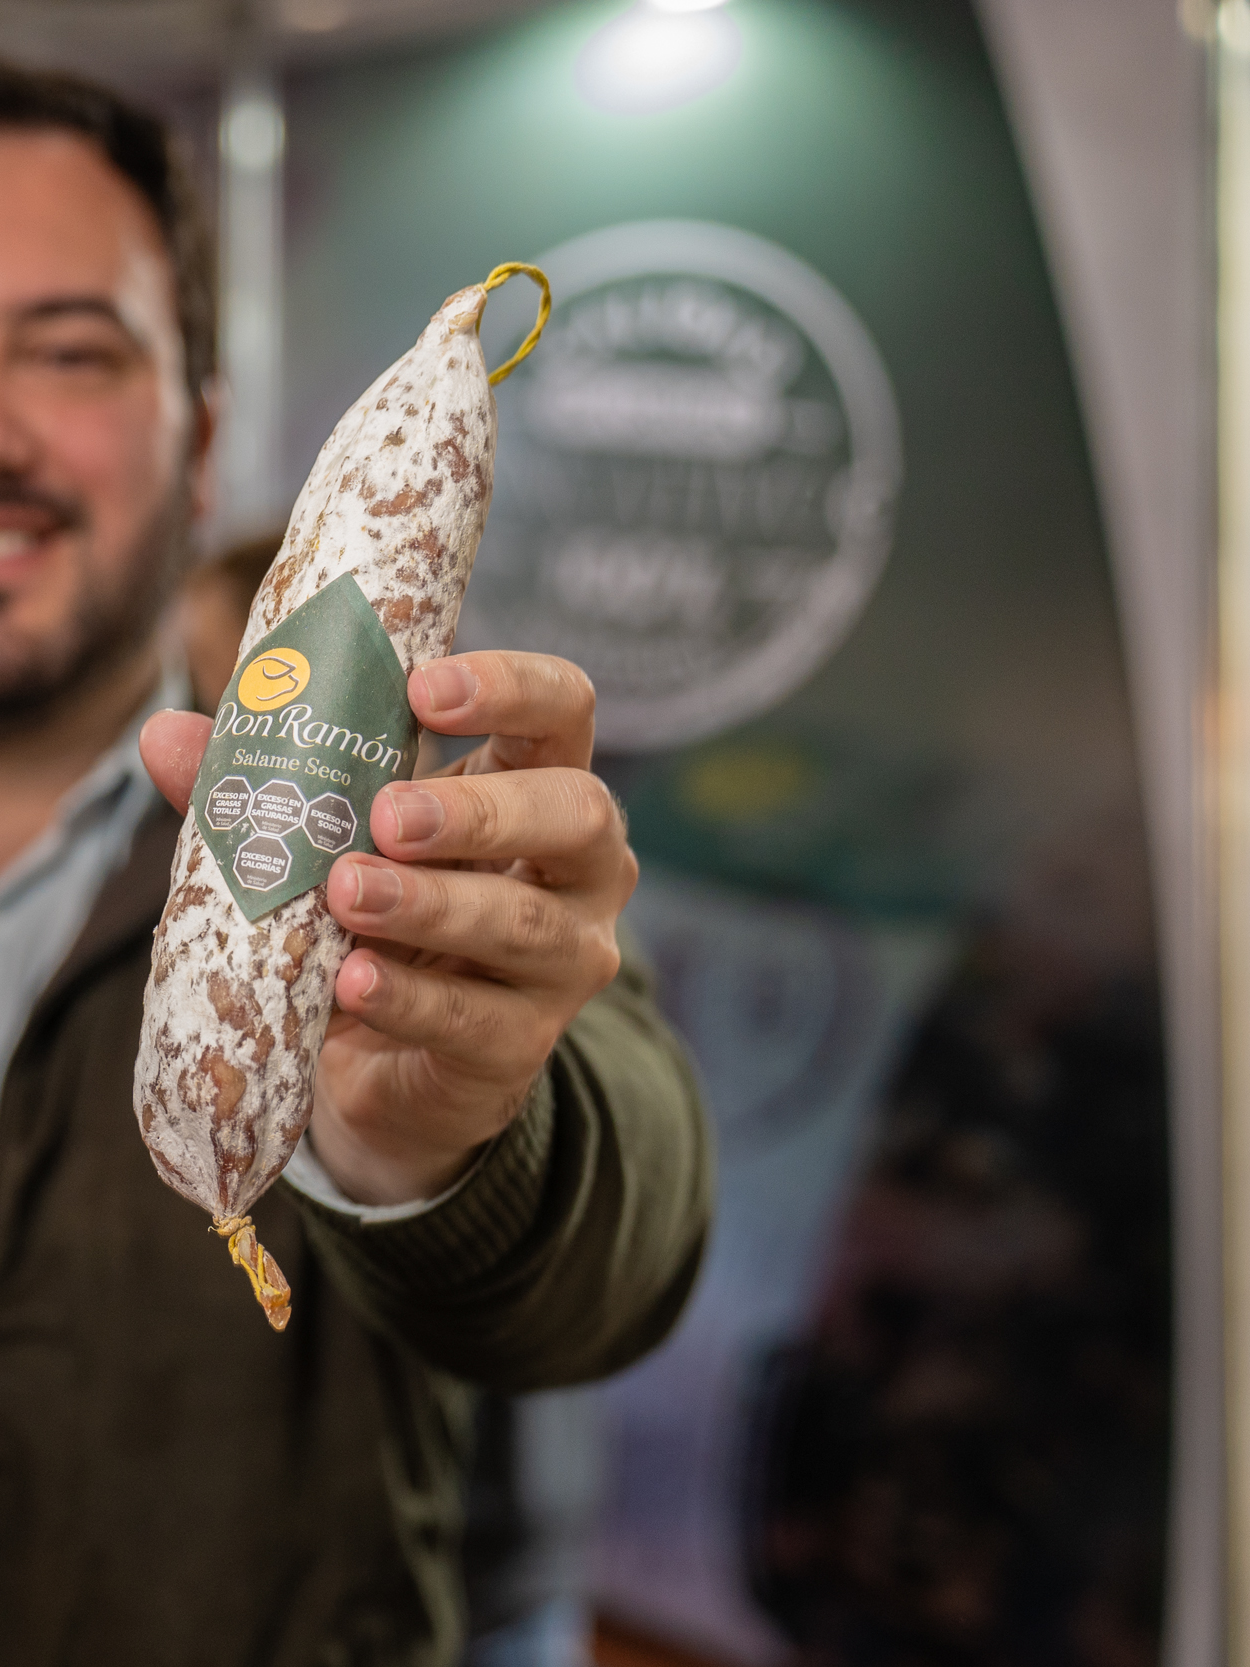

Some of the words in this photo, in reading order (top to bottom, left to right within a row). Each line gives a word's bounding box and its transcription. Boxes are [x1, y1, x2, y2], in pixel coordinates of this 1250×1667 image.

[212, 702, 273, 738] Don
[276, 704, 401, 773] Ramón
[233, 749, 300, 770] Salame
[305, 758, 350, 786] Seco
[213, 792, 238, 800] EXCESO
[258, 794, 288, 804] EXCESO
[289, 799, 301, 807] EN
[261, 803, 292, 813] GRASAS
[251, 810, 299, 824] SATURADAS
[311, 809, 340, 824] EXCESO
[341, 821, 351, 830] EN
[318, 820, 342, 834] SODIO
[241, 852, 272, 863] EXCESO
[273, 857, 285, 866] EN
[241, 860, 281, 873] CALORÍAS
